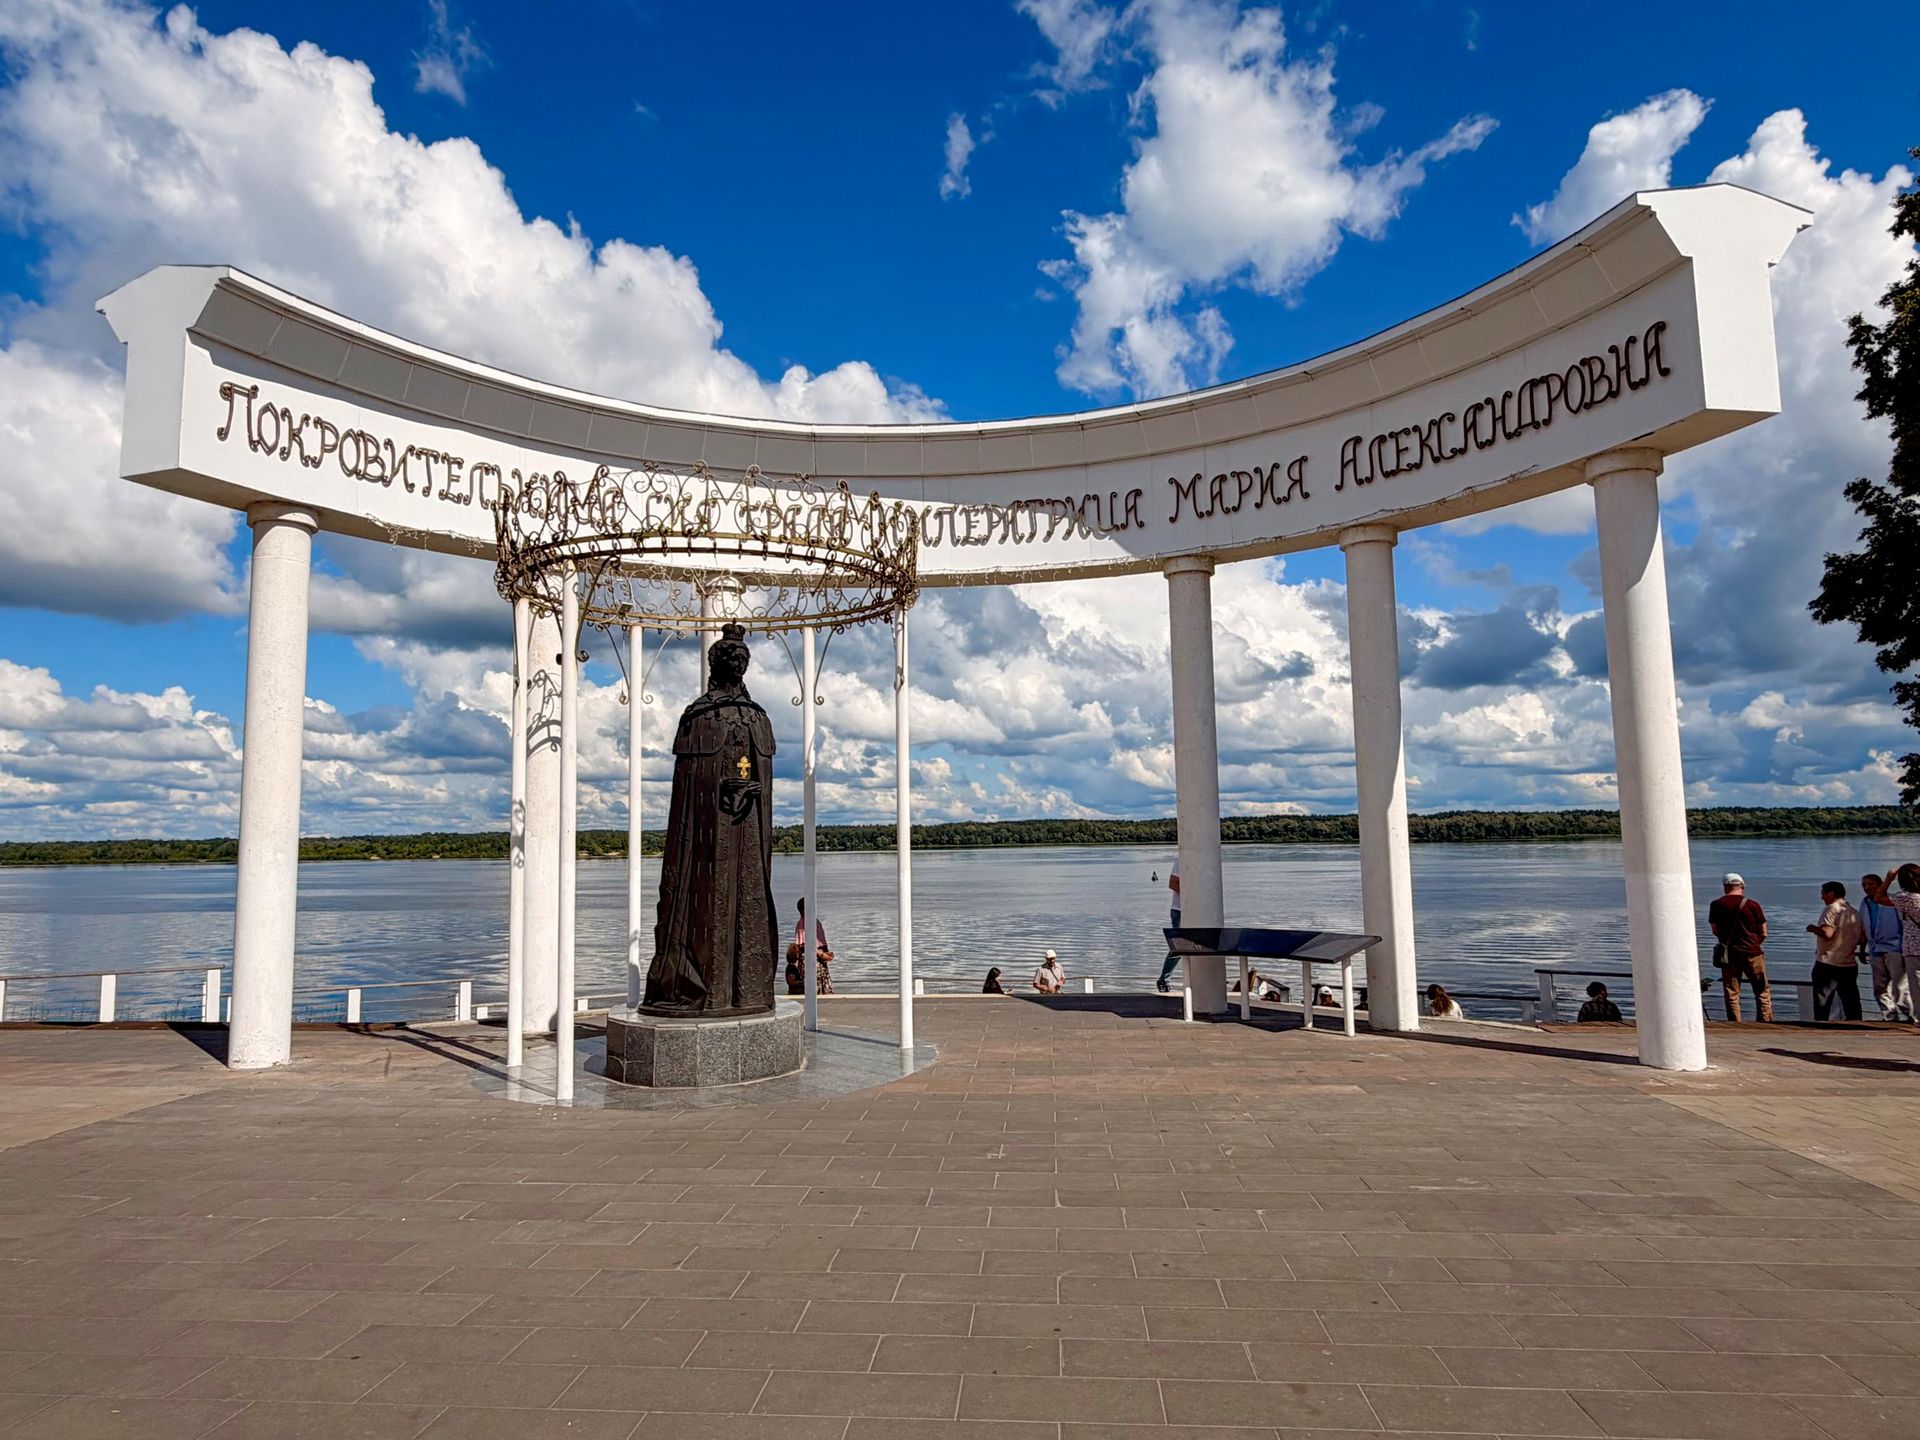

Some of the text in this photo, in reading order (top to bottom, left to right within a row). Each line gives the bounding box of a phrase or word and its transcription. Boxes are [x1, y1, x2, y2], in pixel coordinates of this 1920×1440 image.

[872, 488, 1145, 546] ИМПЕРАТРИЦА
[1168, 456, 1310, 524] МАРИЯ
[1334, 320, 1671, 492] АЛЕКСАНДРОВНА
